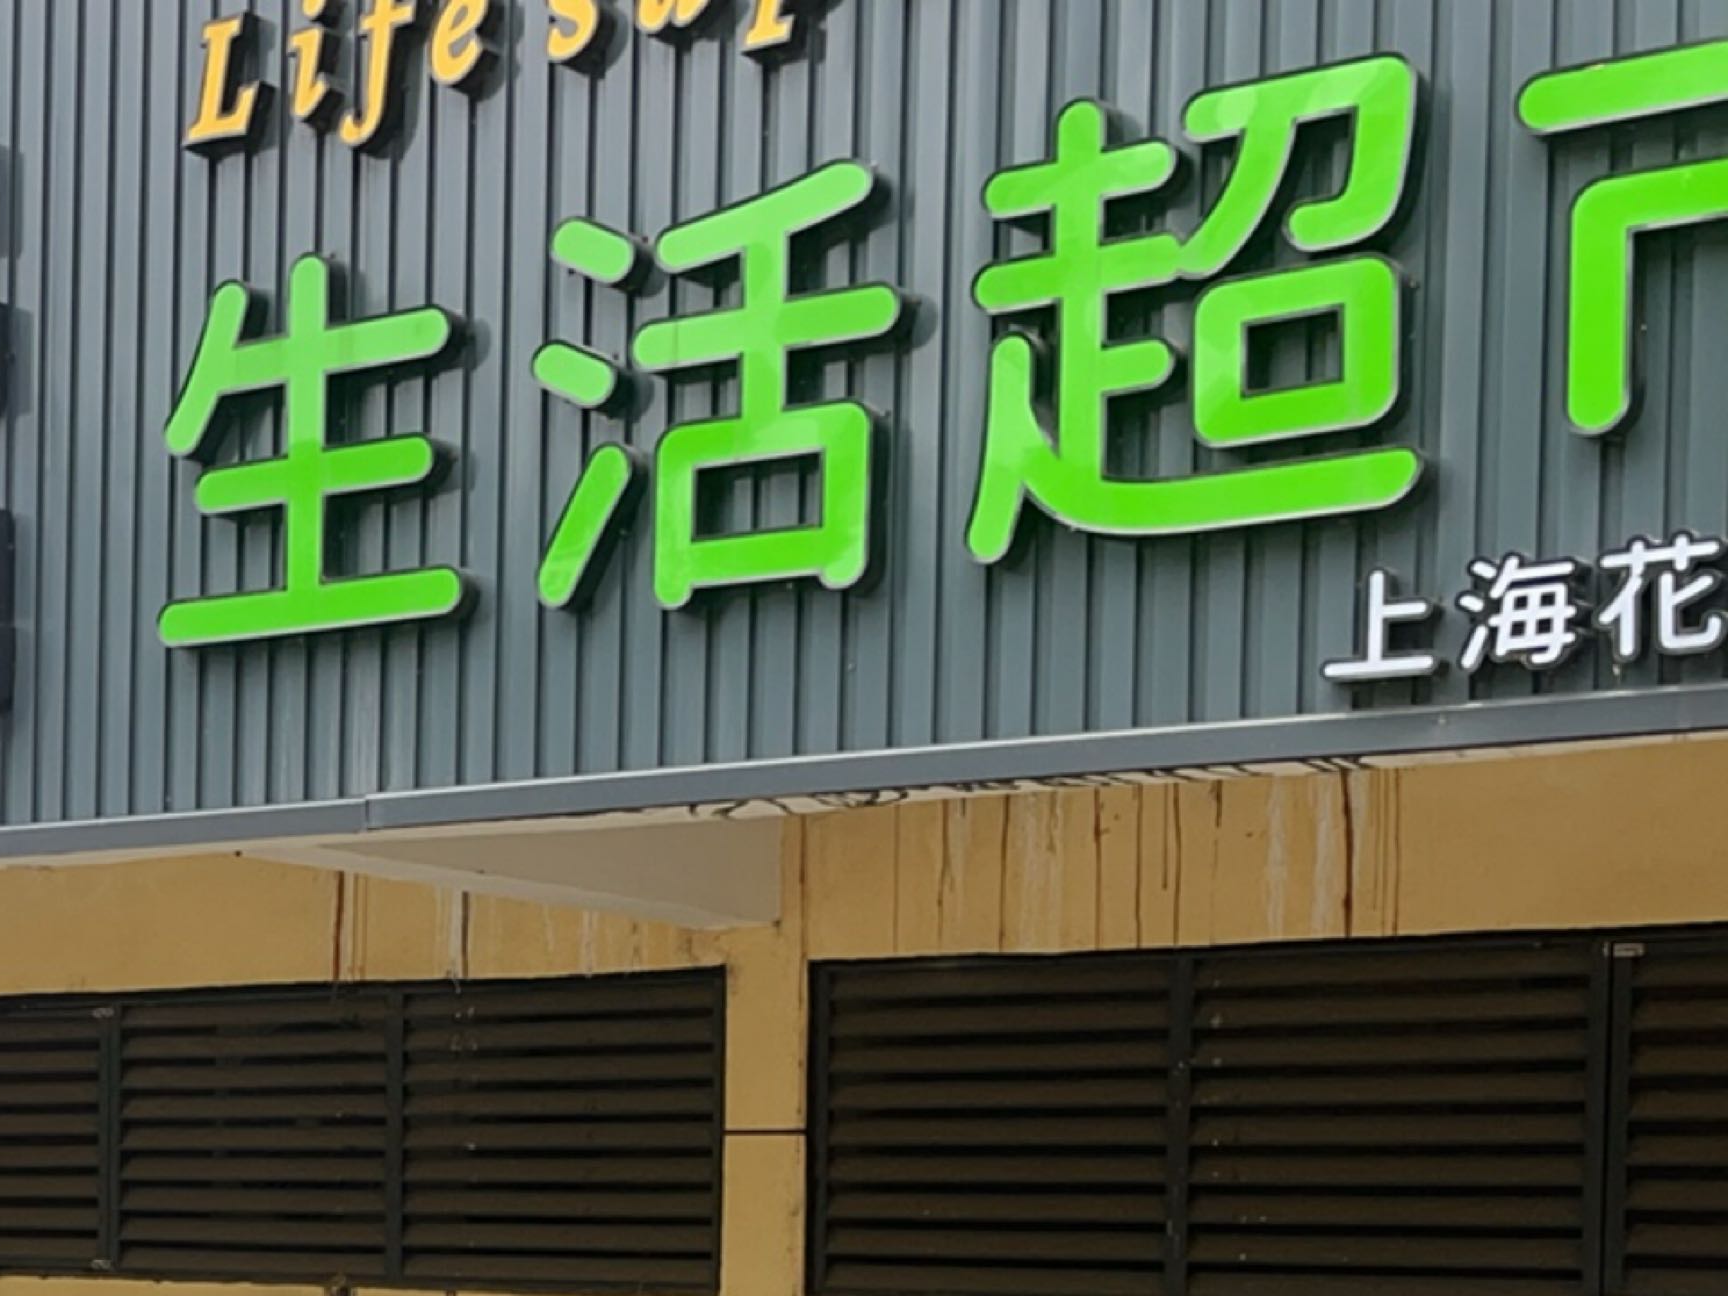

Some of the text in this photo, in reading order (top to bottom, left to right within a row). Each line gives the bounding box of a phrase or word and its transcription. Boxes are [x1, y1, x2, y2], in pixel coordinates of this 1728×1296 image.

[186, 0, 480, 146] Life
[1322, 533, 1722, 679] 上海花
